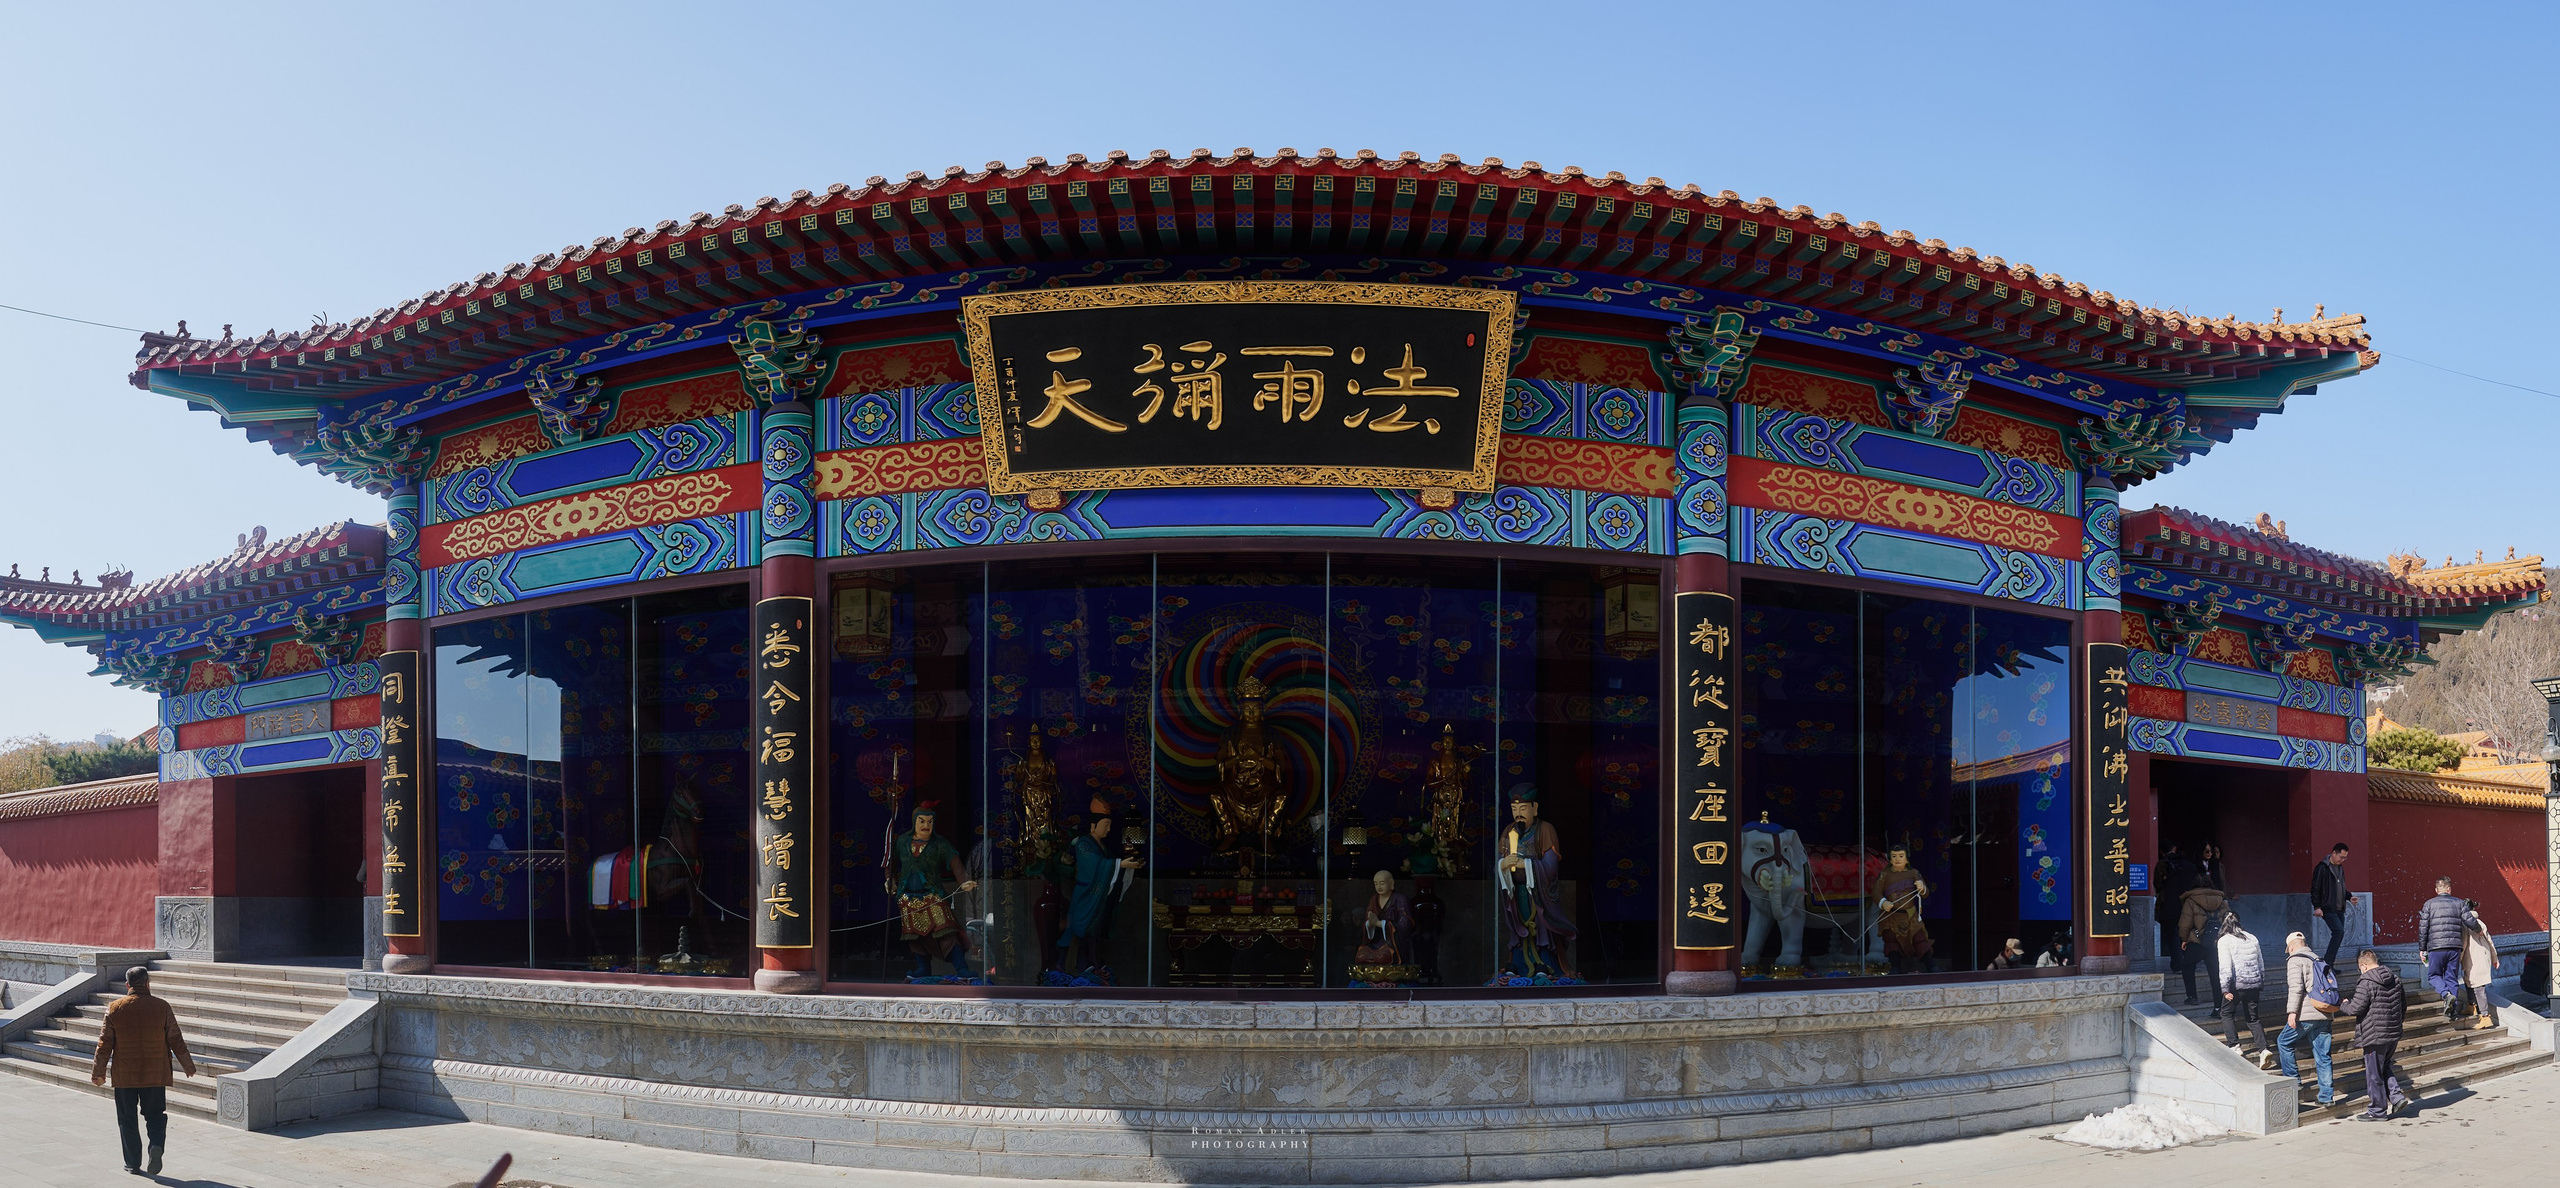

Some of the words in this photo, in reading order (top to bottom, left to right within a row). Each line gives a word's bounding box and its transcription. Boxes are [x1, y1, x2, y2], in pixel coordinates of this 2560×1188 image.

[2099, 666, 2130, 915] 共仰佛光普照
